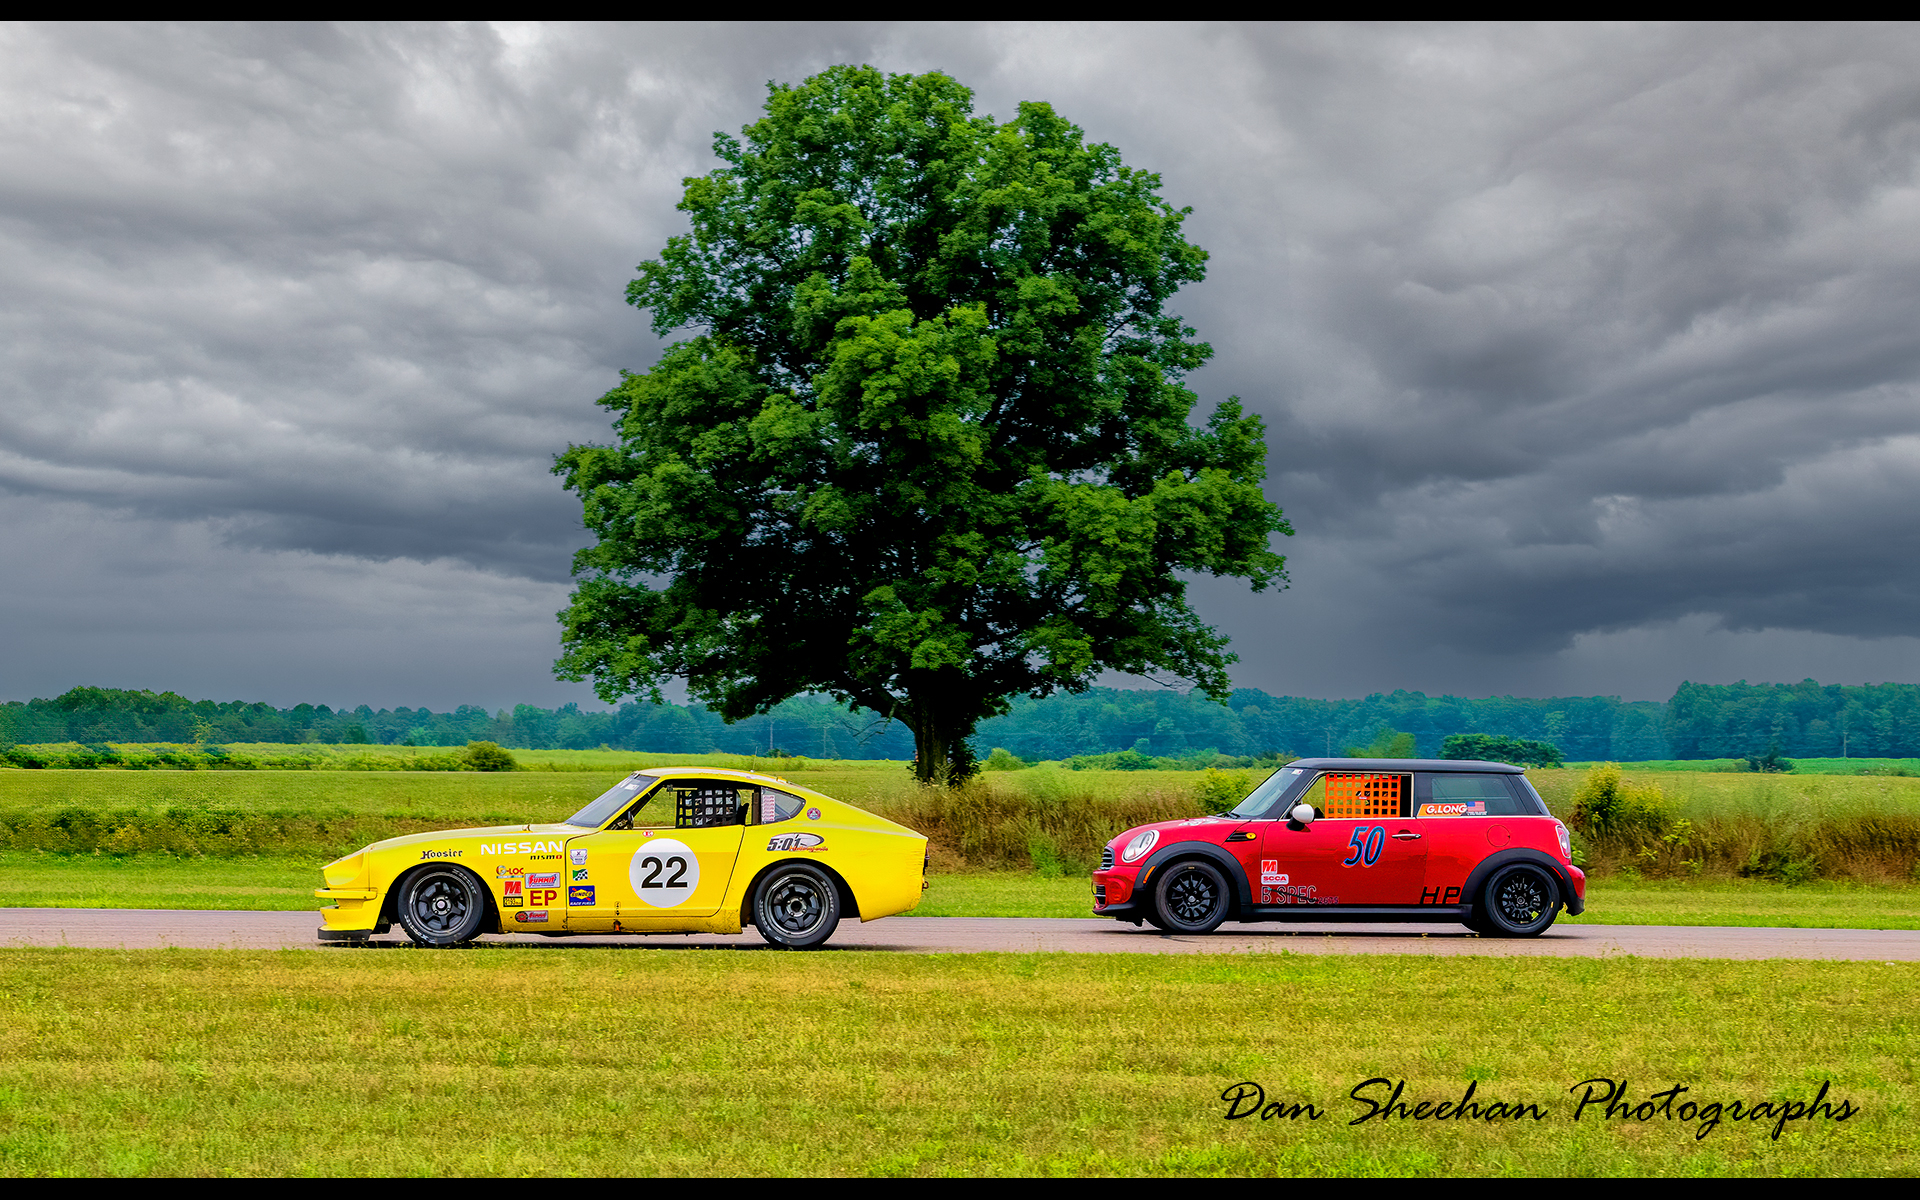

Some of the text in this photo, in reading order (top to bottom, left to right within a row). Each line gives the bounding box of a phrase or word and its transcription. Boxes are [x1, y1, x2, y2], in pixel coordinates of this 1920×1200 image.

[1426, 804, 1468, 815] G.LONG
[420, 849, 463, 859] Hoosier
[480, 840, 563, 855] NISSAN
[1341, 826, 1386, 868] 50
[496, 865, 524, 875] G-LOC
[641, 856, 688, 889] 22
[530, 890, 558, 906] EP
[1261, 886, 1271, 904] B
[1276, 885, 1317, 904] SPEC
